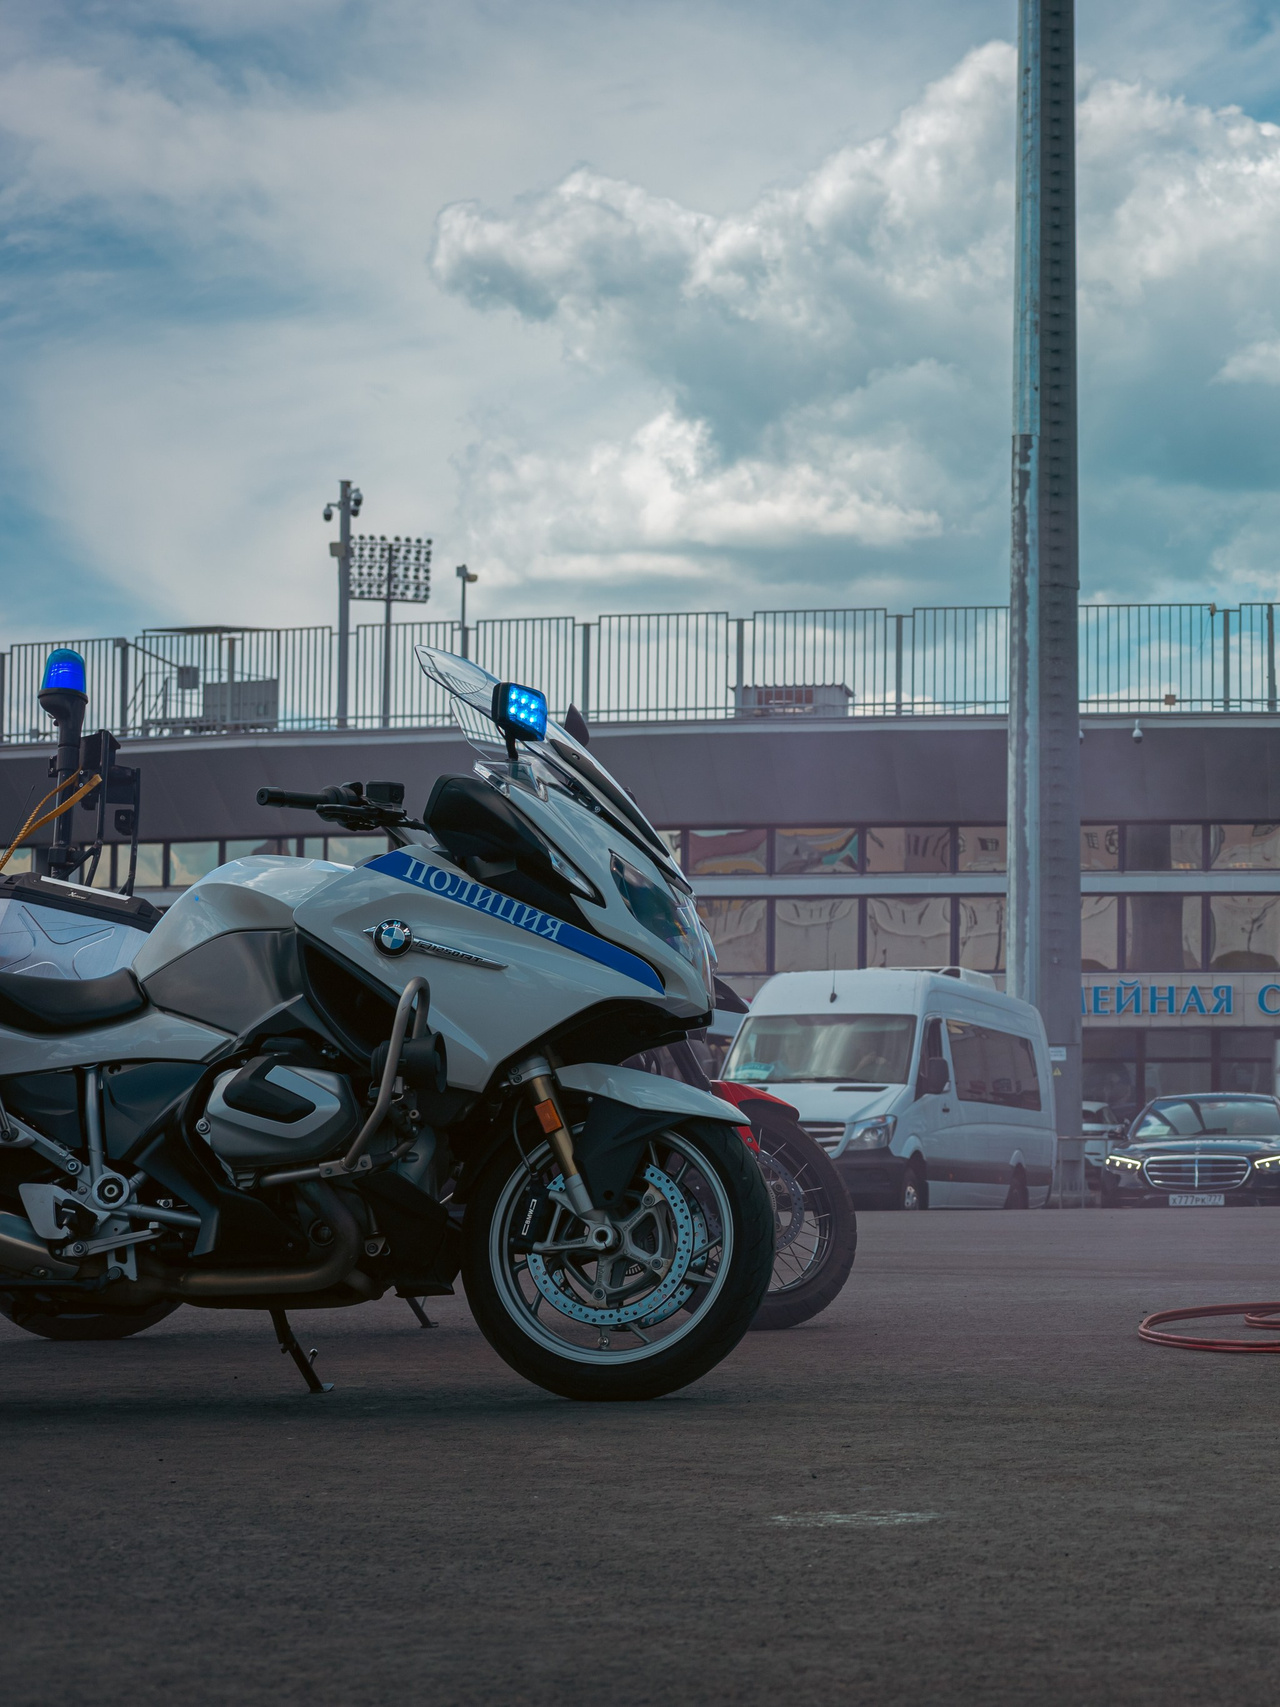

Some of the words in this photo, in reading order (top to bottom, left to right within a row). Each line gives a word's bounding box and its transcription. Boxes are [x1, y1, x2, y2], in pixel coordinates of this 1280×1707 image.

[402, 857, 566, 942] ПОЛИЦИЯ
[380, 920, 411, 937] BMW
[1081, 979, 1233, 1016] ЕЙНАЯ
